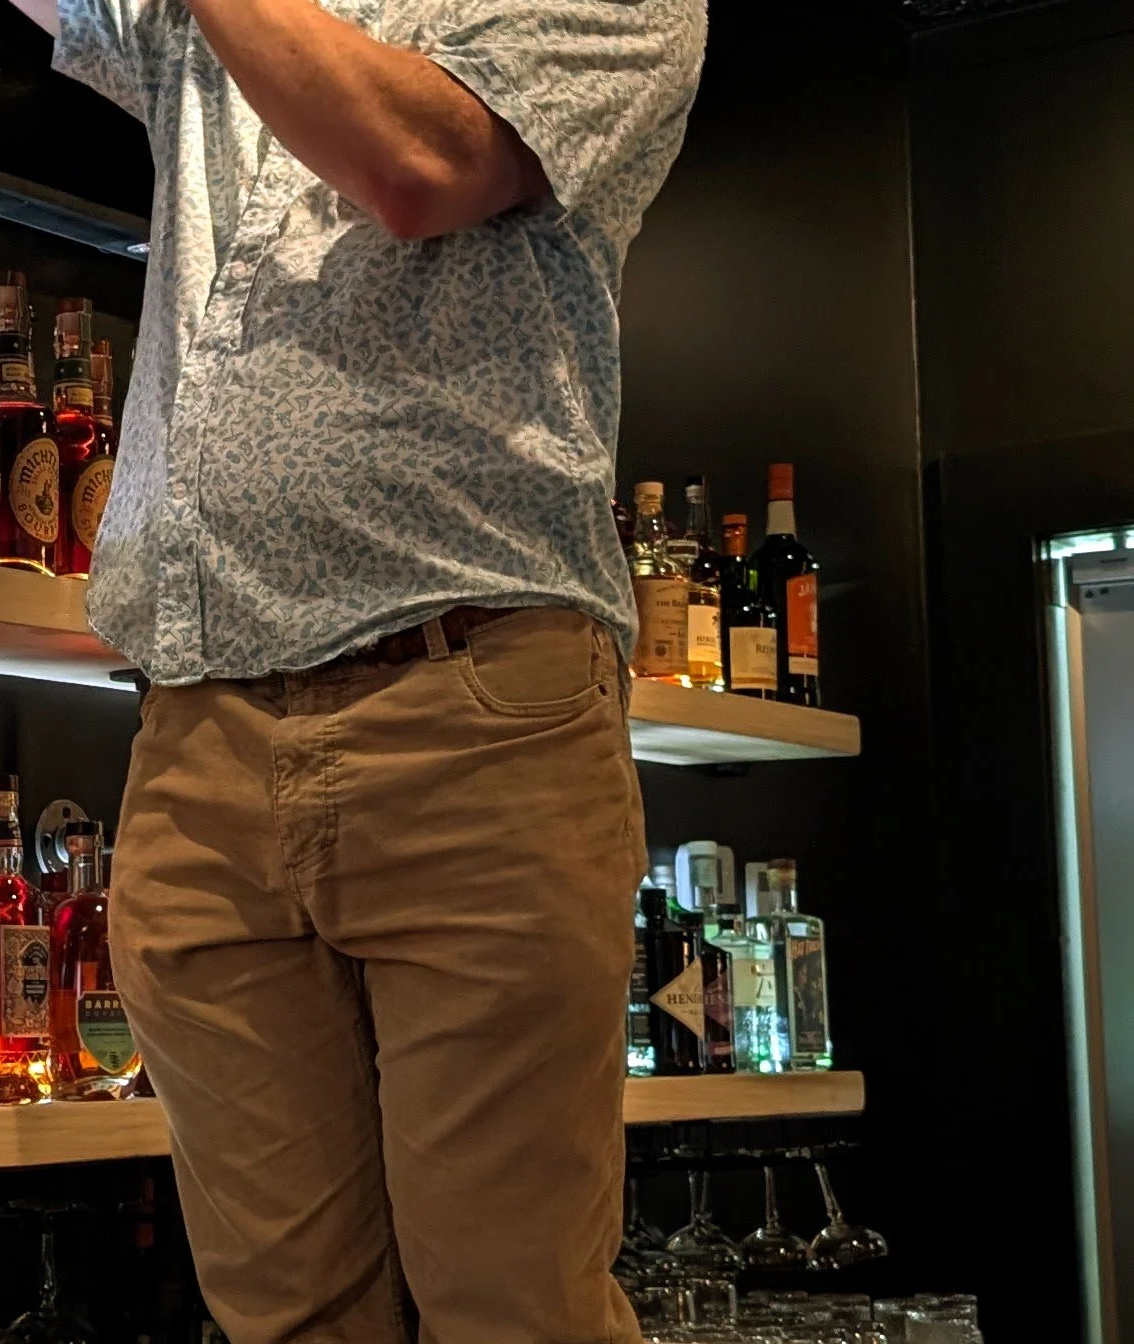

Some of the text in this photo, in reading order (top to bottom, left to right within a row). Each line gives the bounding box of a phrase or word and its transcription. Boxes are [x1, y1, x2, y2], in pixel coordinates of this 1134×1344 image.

[19, 448, 59, 485] MICHT
[17, 503, 57, 536] BOURB
[84, 1000, 120, 1010] BARR
